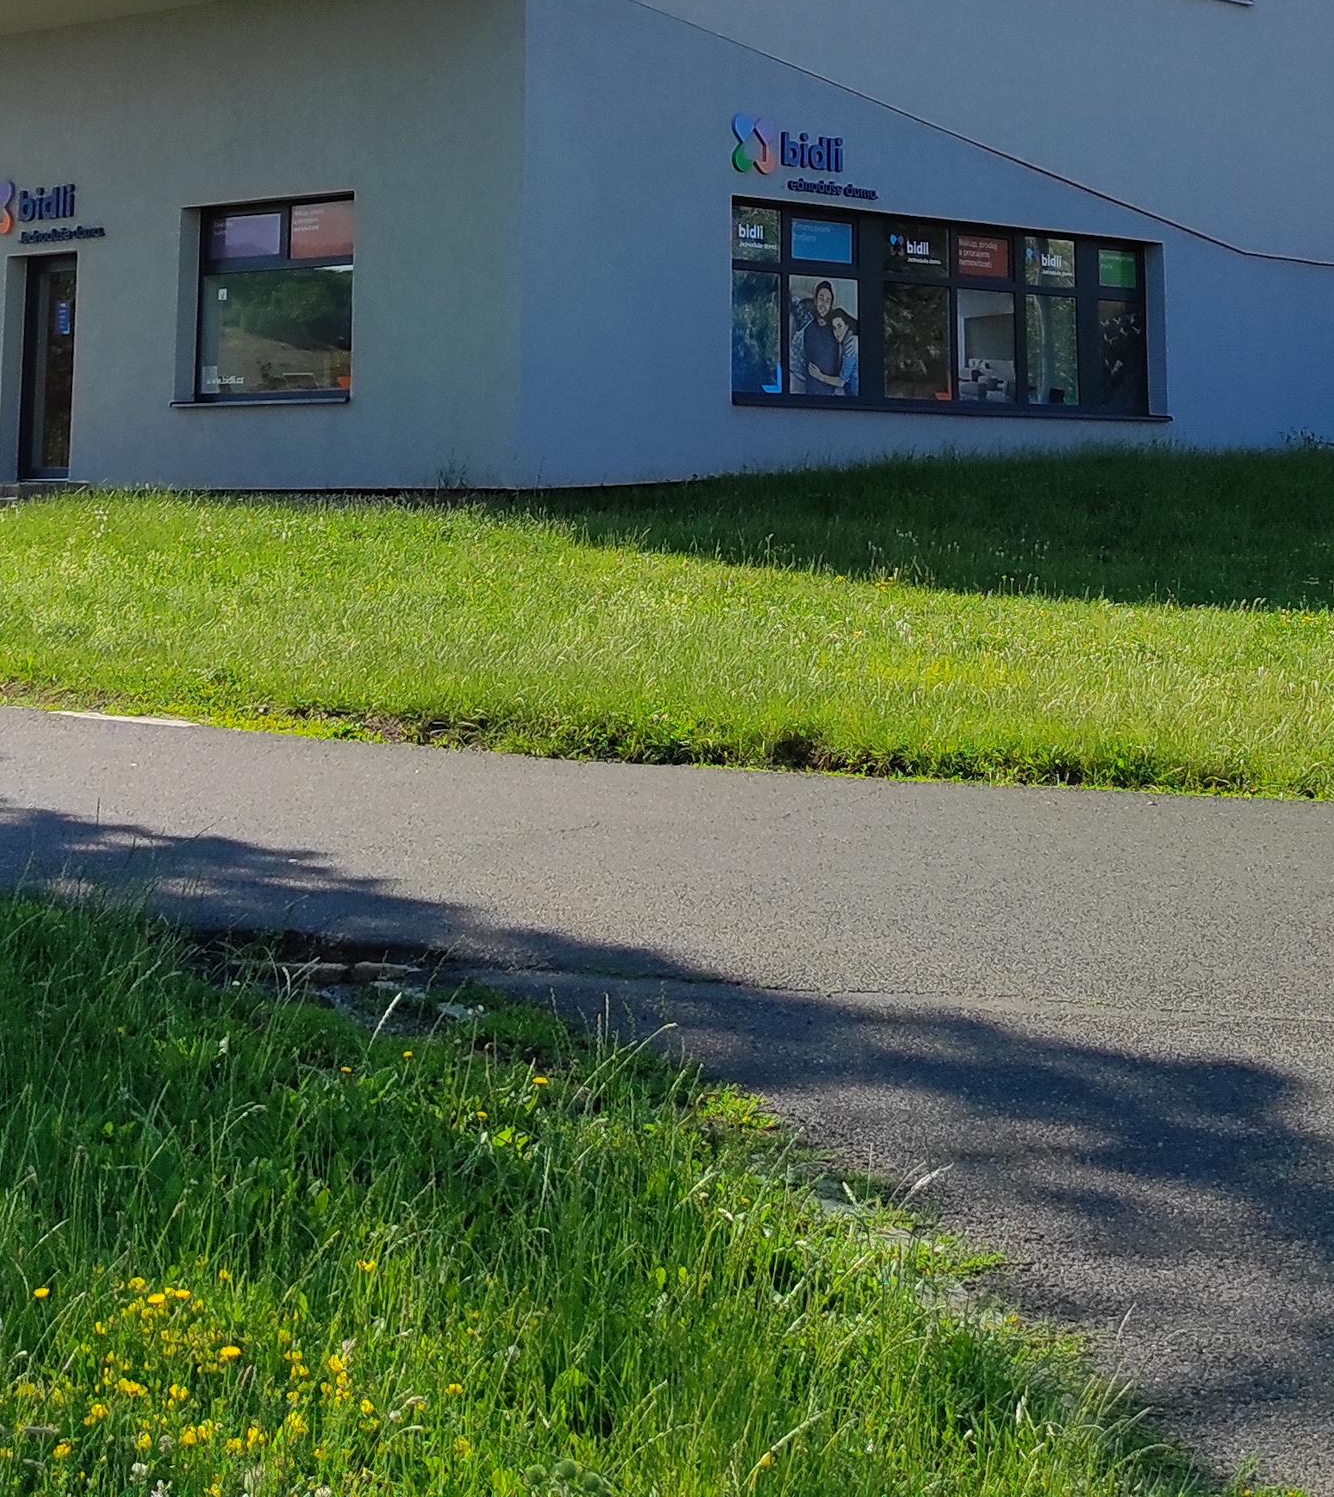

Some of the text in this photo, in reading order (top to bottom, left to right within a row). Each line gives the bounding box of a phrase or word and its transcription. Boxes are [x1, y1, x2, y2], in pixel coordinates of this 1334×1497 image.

[780, 131, 843, 173] bidli
[18, 184, 75, 222] bidli
[738, 223, 764, 240] bidli
[906, 241, 929, 256] bidli
[1041, 253, 1063, 269] bidli
